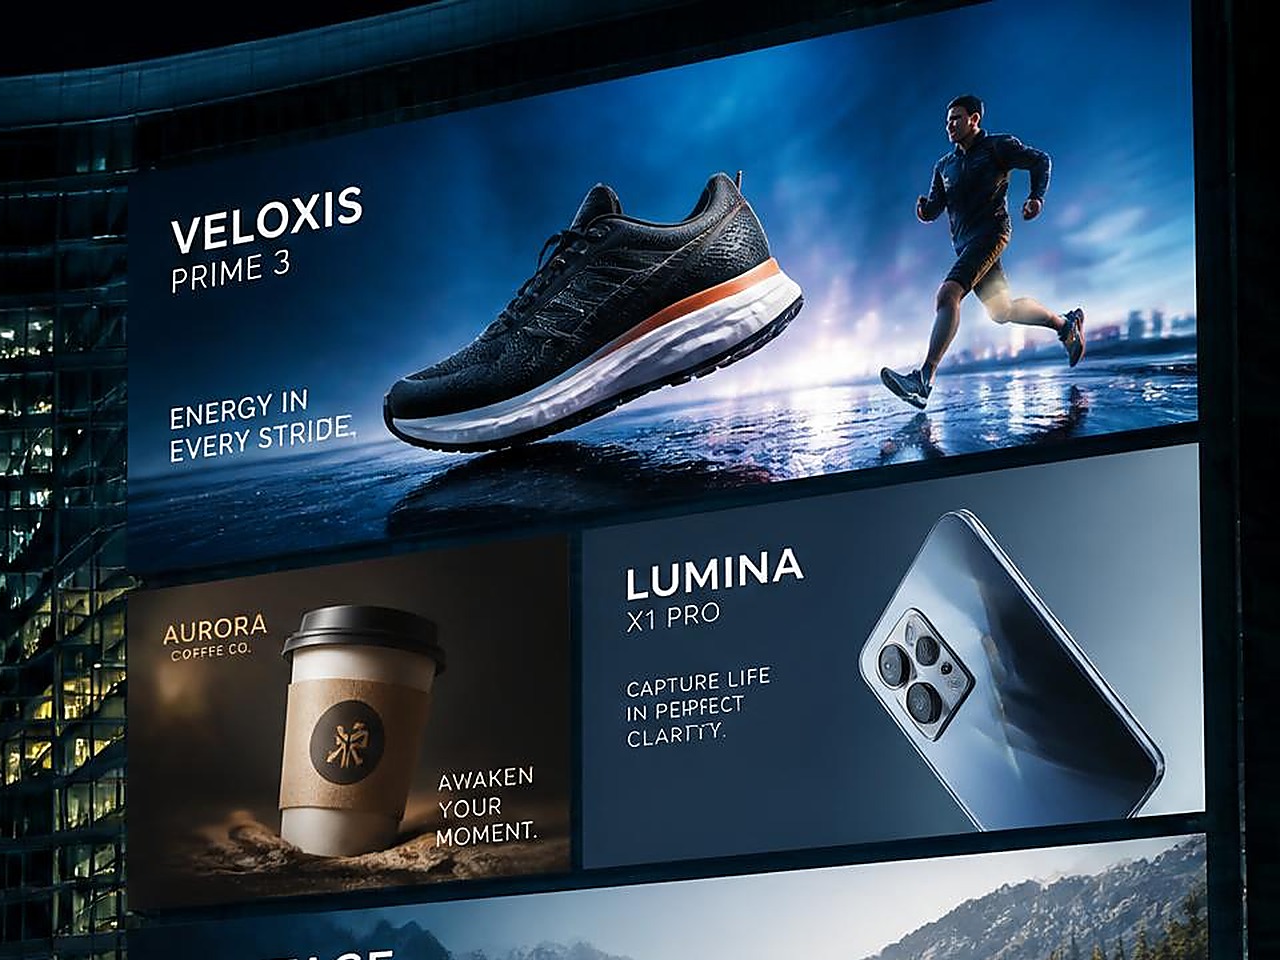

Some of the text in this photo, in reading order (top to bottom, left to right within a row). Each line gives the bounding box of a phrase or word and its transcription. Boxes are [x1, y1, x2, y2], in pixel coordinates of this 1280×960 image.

[171, 186, 363, 254] VELOXIS
[172, 249, 290, 294] PRIME 3
[170, 388, 308, 430] ENERGY IN
[170, 429, 250, 463] EVERY
[627, 548, 804, 601] LUMINA
[163, 613, 267, 645] AURORA
[627, 601, 720, 633] X1 PRO
[228, 642, 252, 655] CO.
[627, 666, 770, 698] CAPTURE LIFE
[627, 705, 647, 722] IN
[438, 766, 533, 791] AWAKEN
[438, 796, 501, 819] YOUR
[436, 820, 538, 848] MOMENT.
